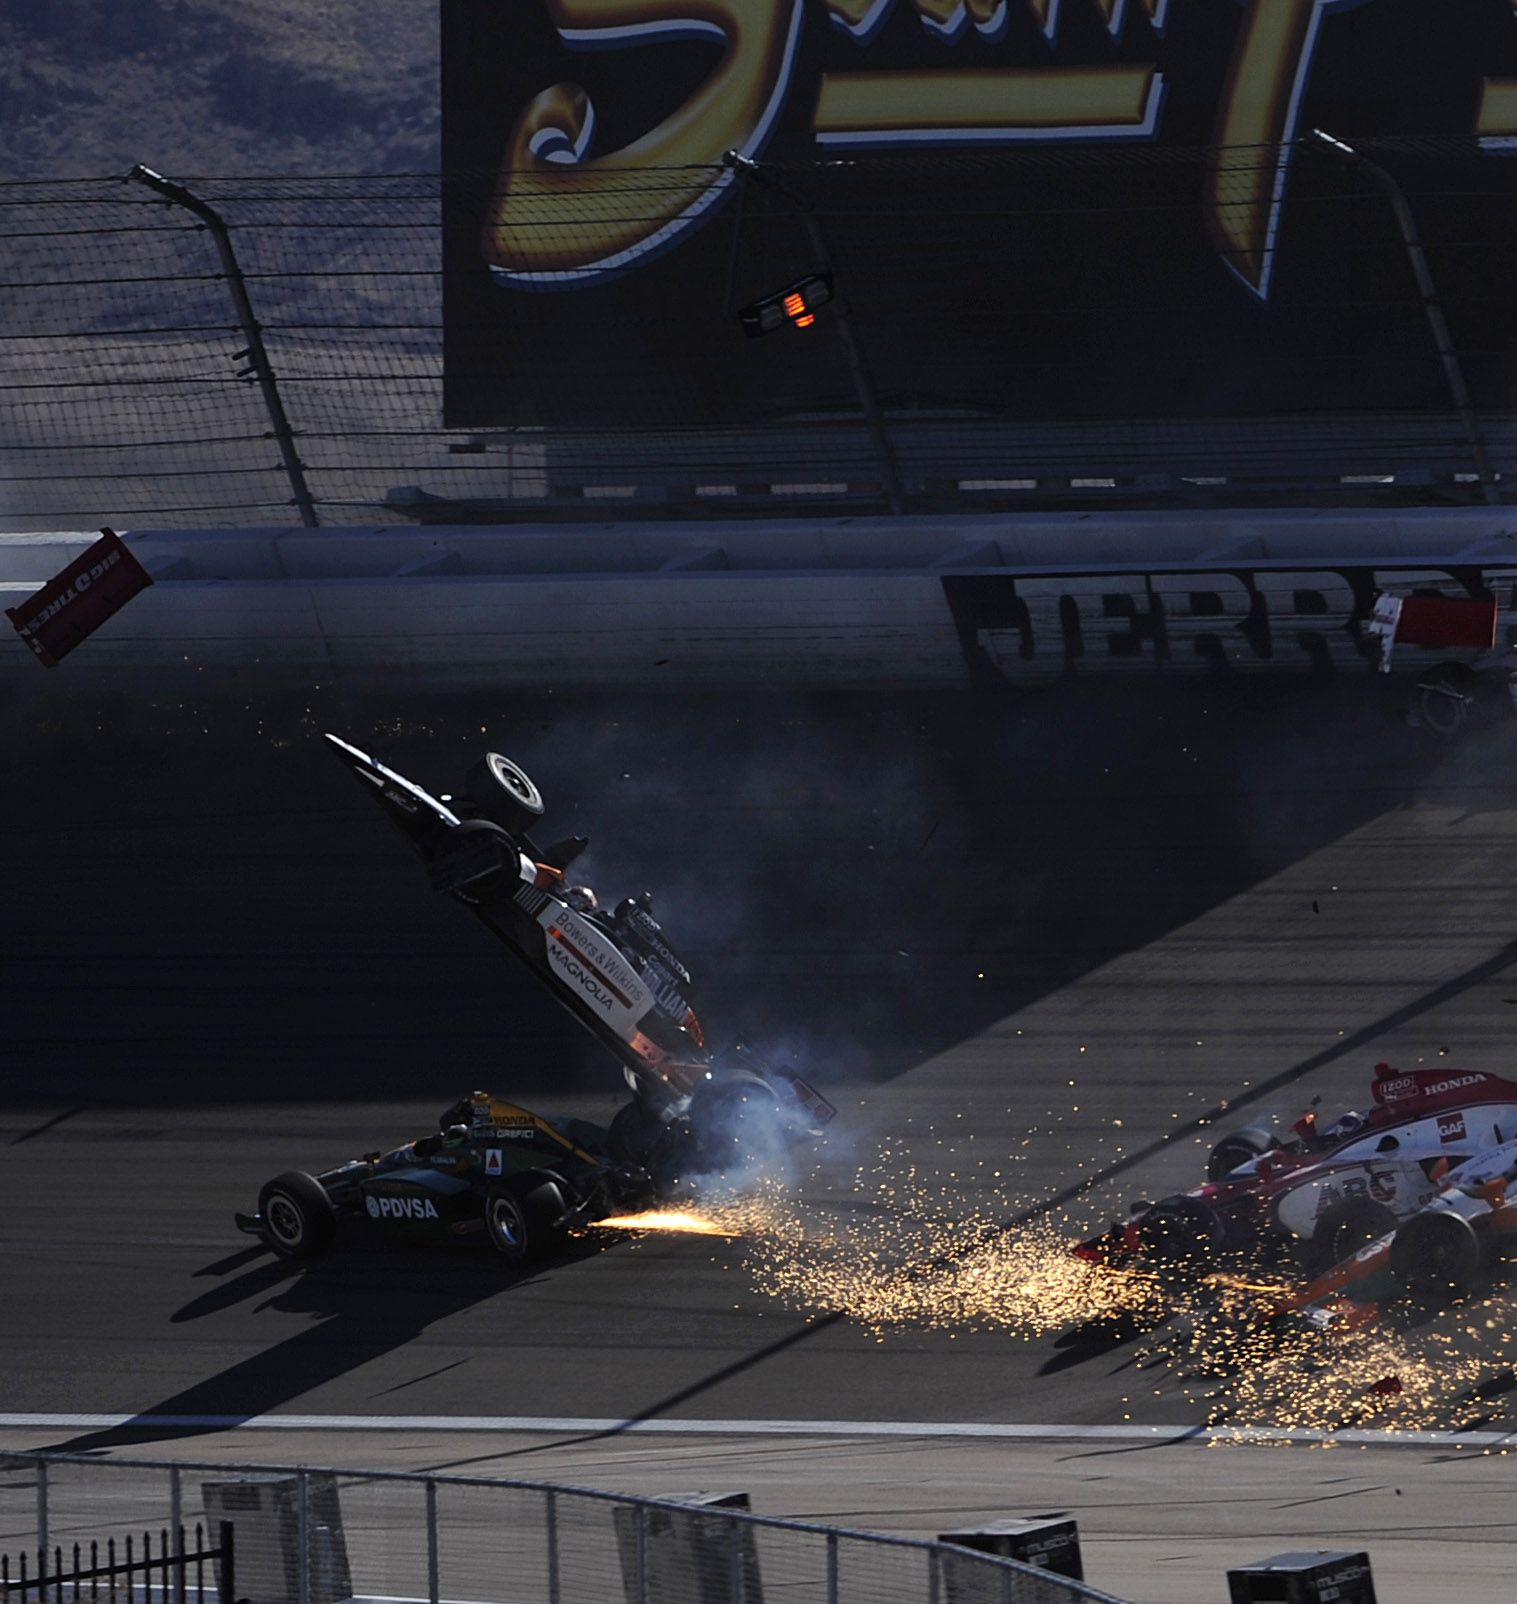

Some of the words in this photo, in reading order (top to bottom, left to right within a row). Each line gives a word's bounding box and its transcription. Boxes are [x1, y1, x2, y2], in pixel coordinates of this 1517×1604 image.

[555, 912, 603, 958] Bowers
[604, 958, 645, 1001] Wilkins
[650, 937, 691, 984] HONDA
[549, 945, 616, 1011] MAGNOLIA
[1381, 1078, 1412, 1094] IZOD
[1423, 1072, 1488, 1096] HONDA
[1438, 1120, 1466, 1137] GAF
[378, 1196, 439, 1219] PDVSA
